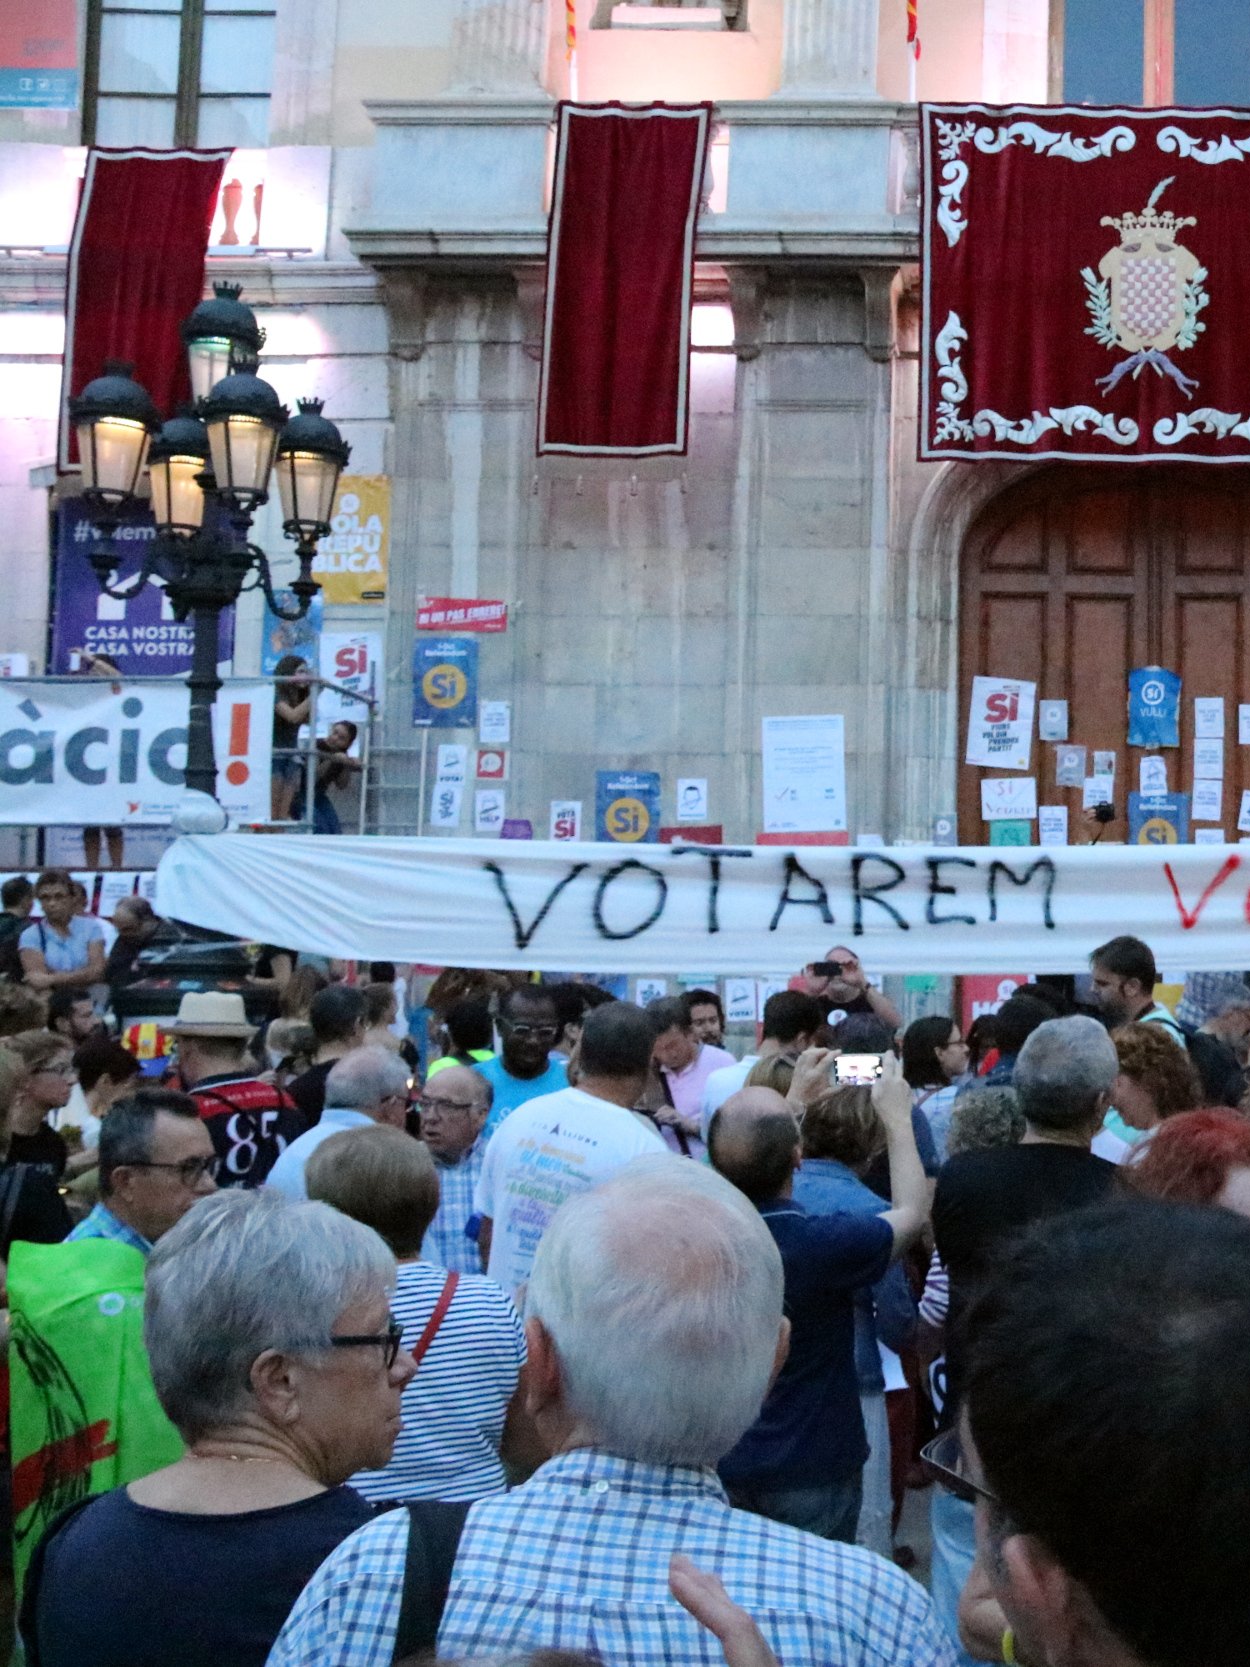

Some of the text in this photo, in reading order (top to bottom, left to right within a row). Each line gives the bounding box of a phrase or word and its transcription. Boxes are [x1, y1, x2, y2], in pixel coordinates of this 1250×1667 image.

[331, 514, 382, 533] OLA
[85, 626, 129, 640] CASA
[484, 844, 1056, 949] VOTAREM
